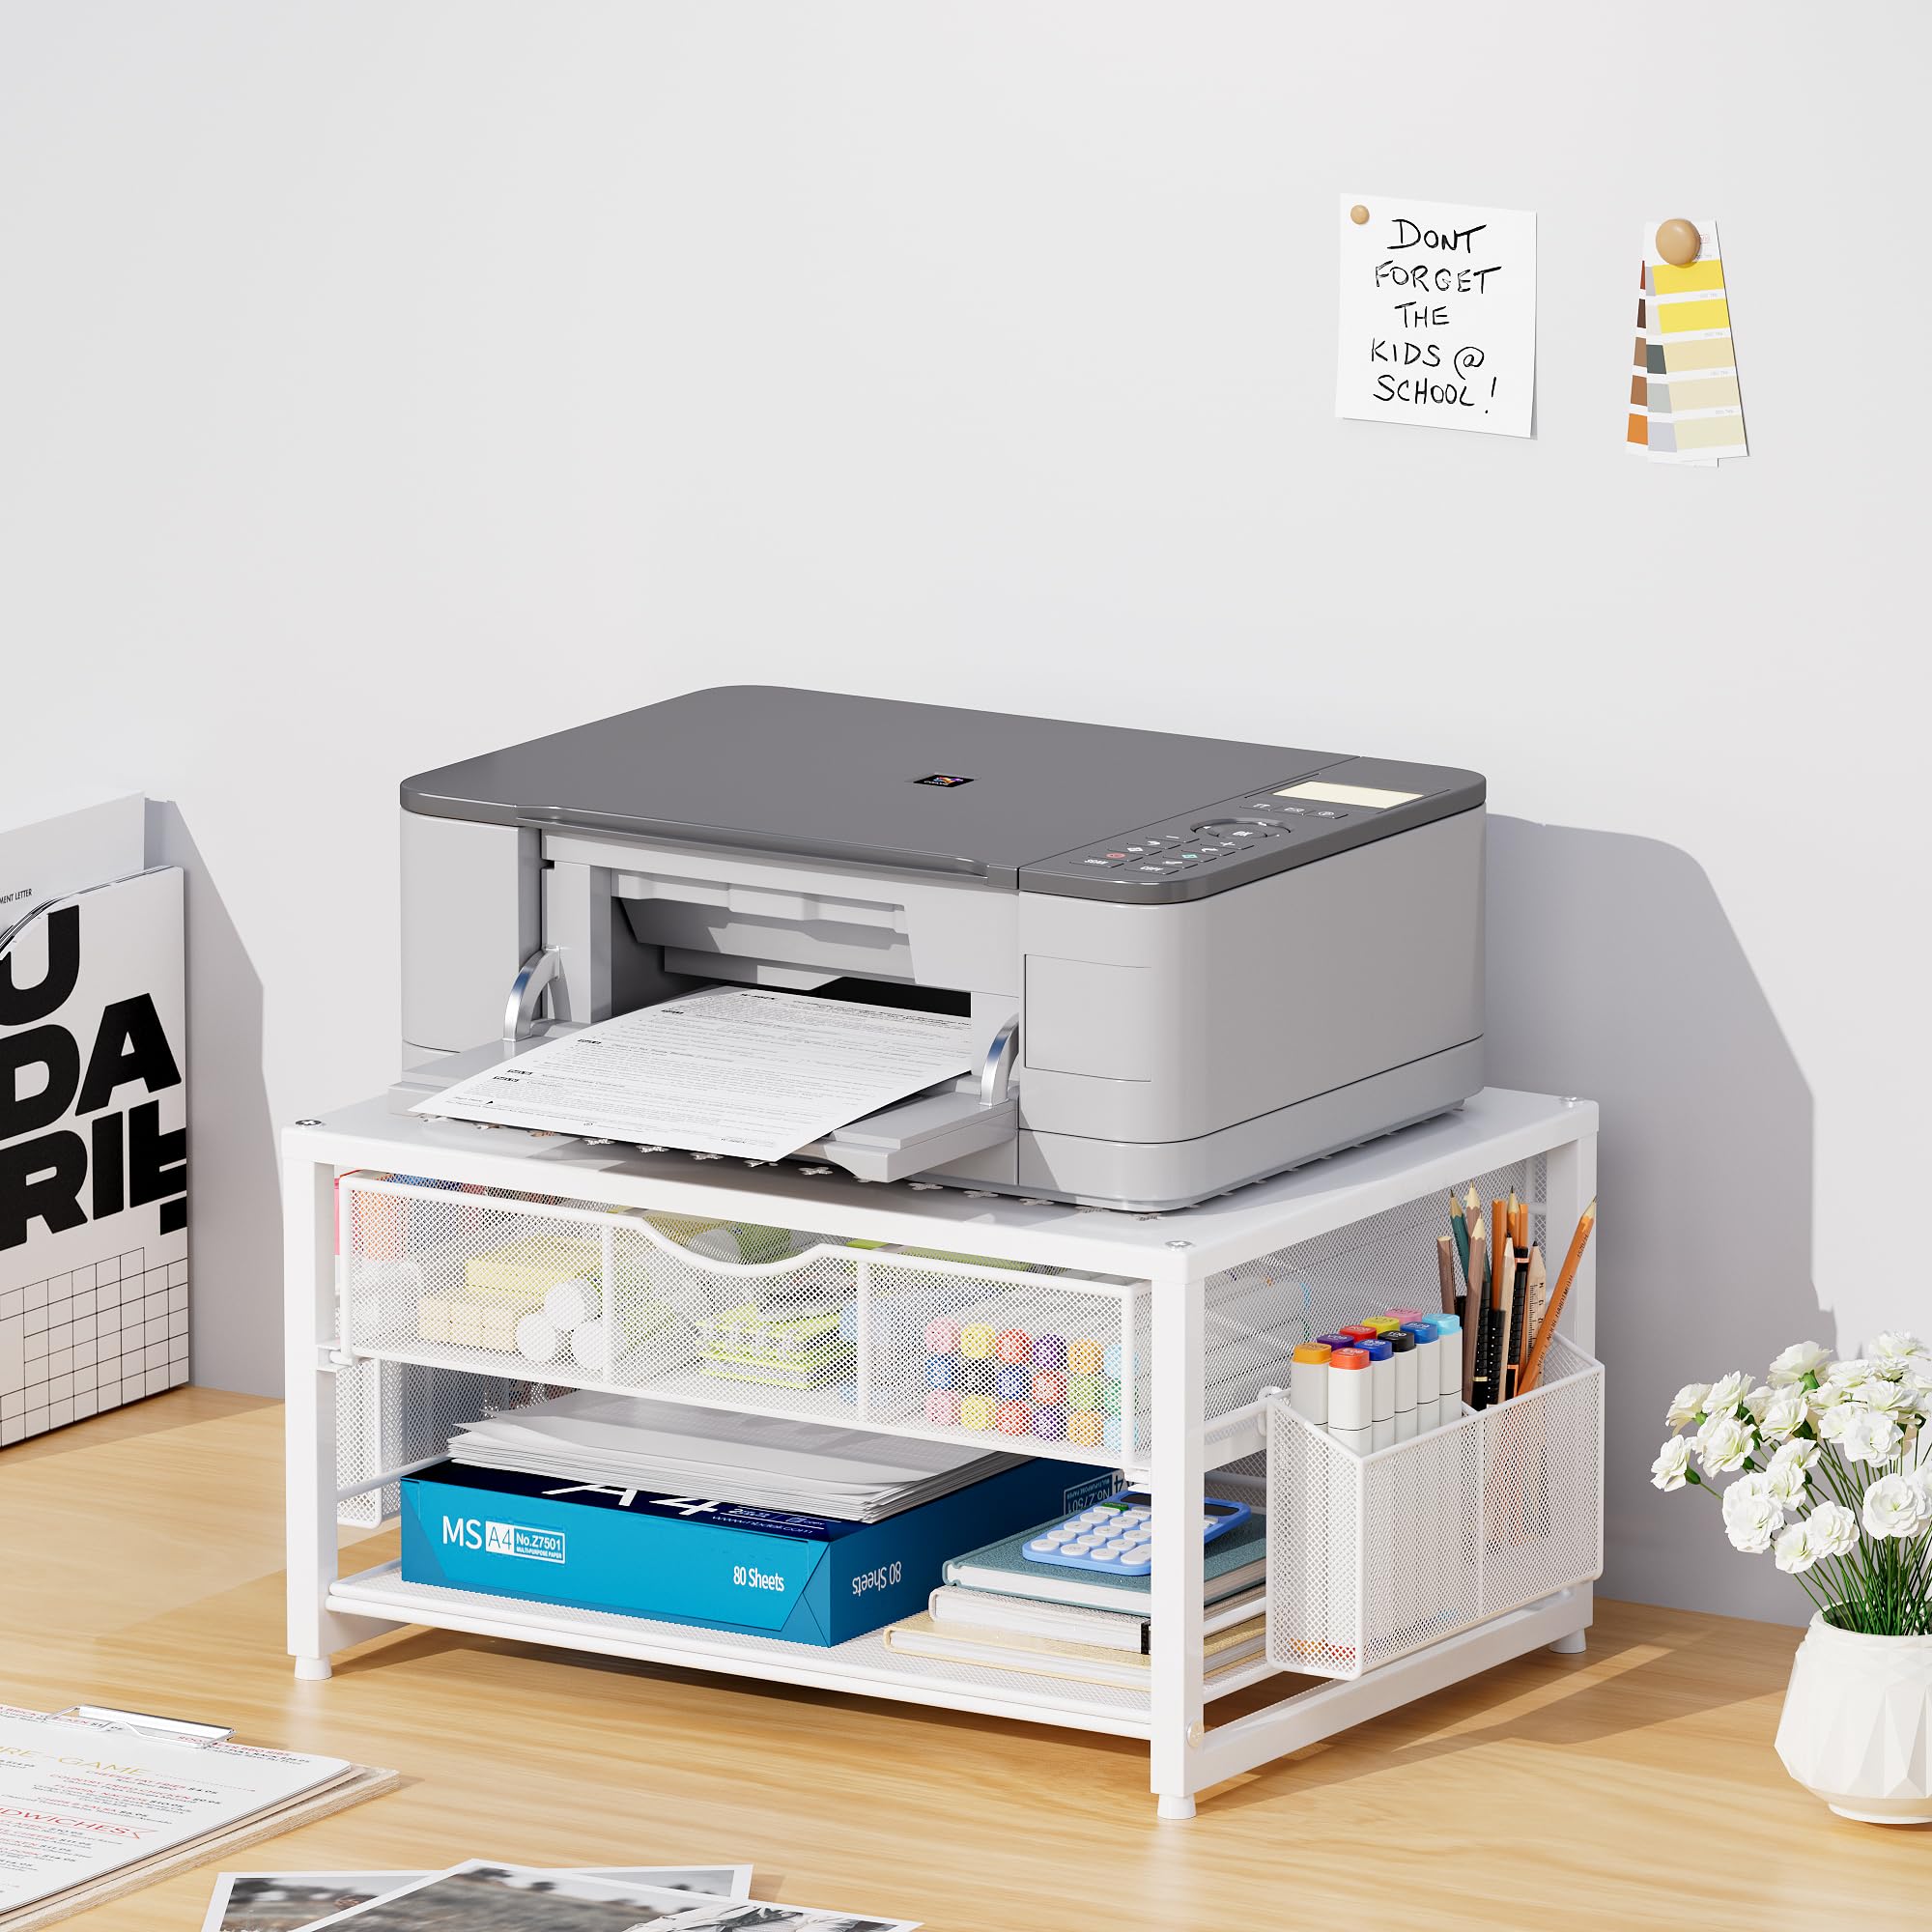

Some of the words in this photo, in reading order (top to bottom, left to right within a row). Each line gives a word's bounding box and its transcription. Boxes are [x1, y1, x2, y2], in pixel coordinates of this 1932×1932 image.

[1387, 218, 1488, 253] DONT
[1376, 259, 1502, 295] FORGET
[1394, 301, 1450, 328] THE
[1371, 338, 1441, 367] KIDS
[1454, 346, 1485, 381] @
[14, 888, 33, 901] LETTER
[441, 1515, 483, 1549] MS
[488, 1526, 513, 1550] A4
[515, 1532, 562, 1551] No.Z7501
[548, 1550, 563, 1559] PAPER
[733, 1565, 747, 1586] 80
[748, 1567, 785, 1592] Sheets
[852, 1566, 887, 1597] Sheets
[889, 1560, 902, 1586] 80
